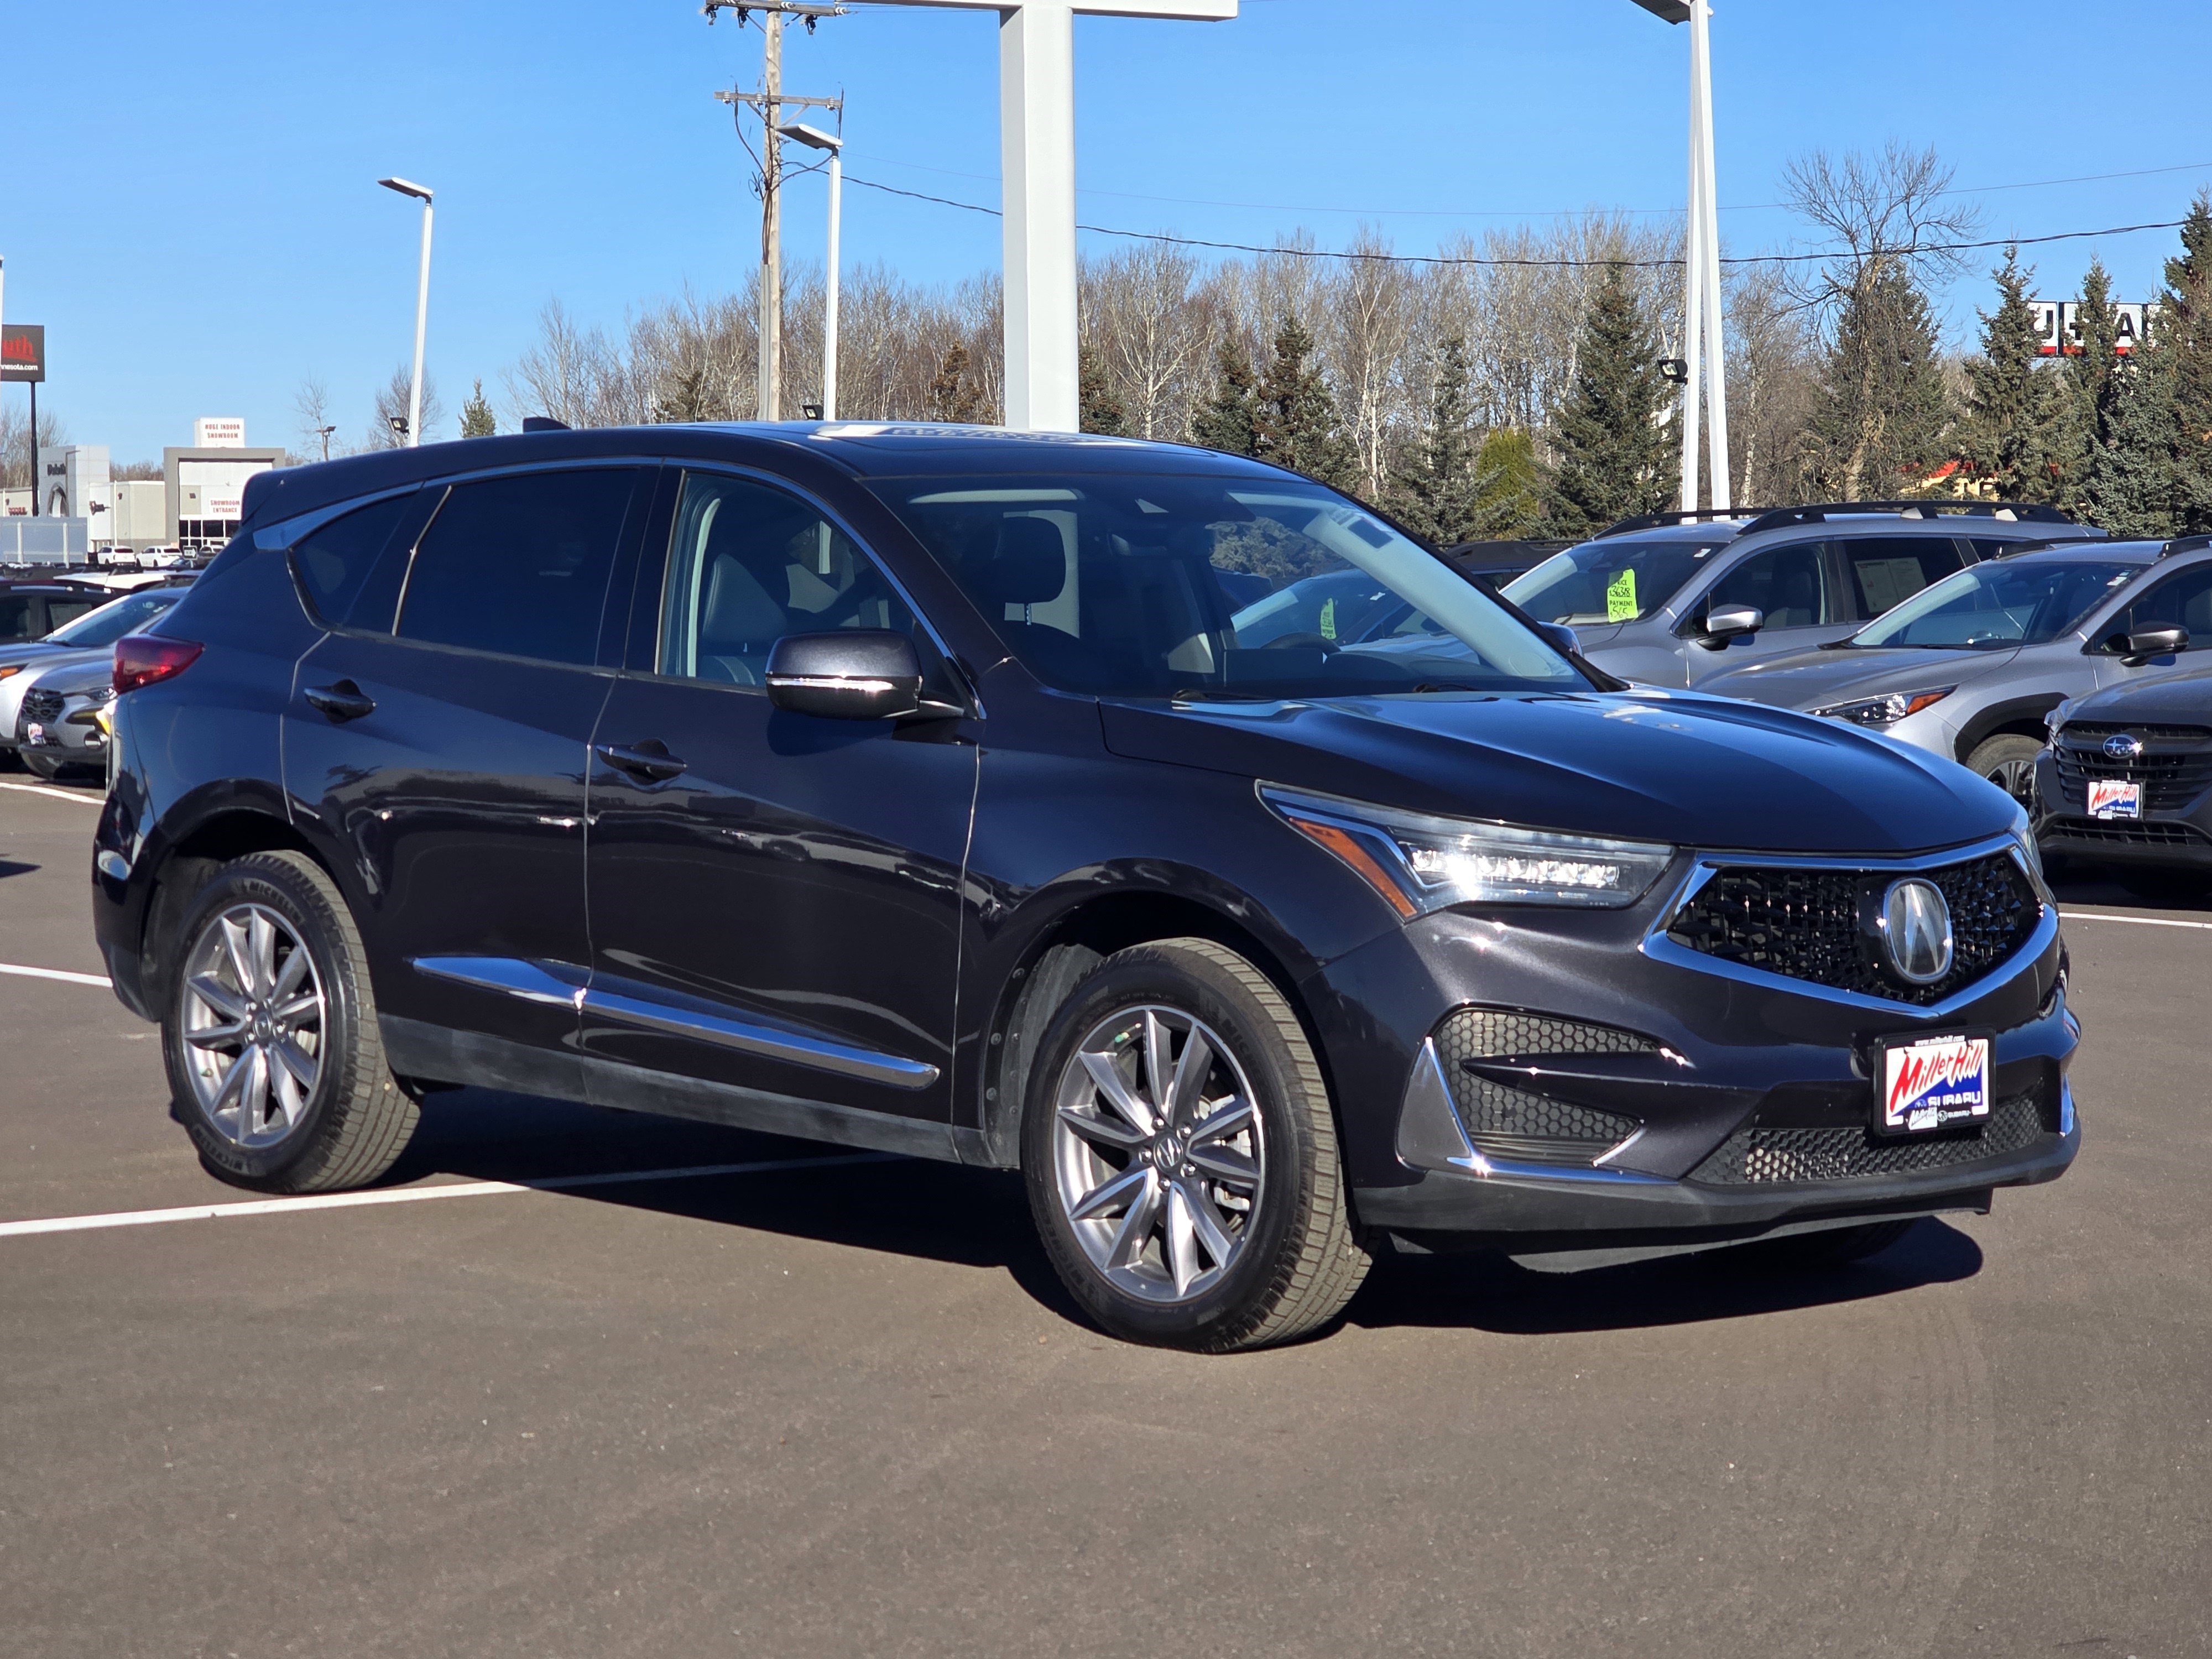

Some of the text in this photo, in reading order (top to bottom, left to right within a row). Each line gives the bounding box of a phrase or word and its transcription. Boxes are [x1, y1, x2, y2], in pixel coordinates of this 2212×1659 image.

[2091, 787, 2122, 809] Miller
[1890, 1042, 1984, 1113] Miller Hill
